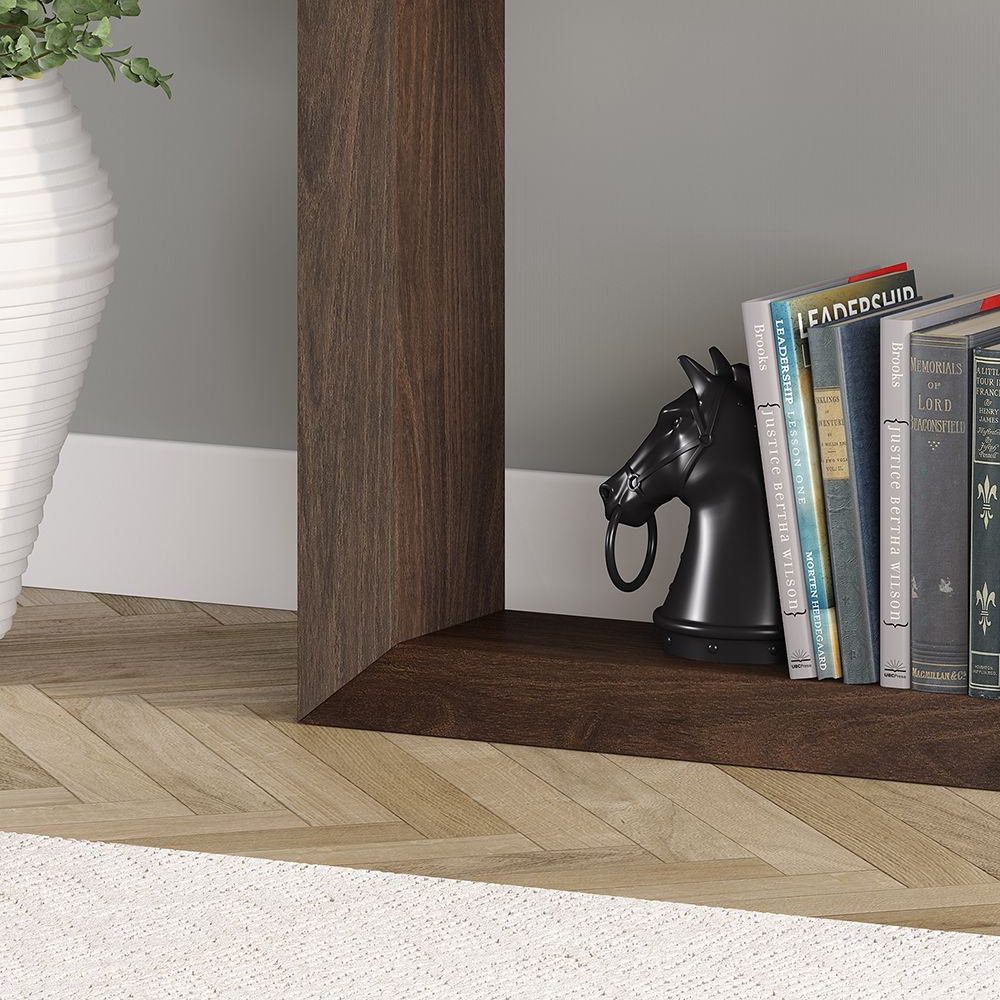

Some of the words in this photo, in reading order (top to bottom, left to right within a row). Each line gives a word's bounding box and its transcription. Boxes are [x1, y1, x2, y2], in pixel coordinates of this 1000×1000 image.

[753, 323, 768, 372] Brooks
[891, 342, 904, 388] Brooks
[911, 356, 963, 375] MEMORIALS
[927, 381, 941, 390] OF
[976, 377, 994, 387] TOUR
[774, 319, 794, 405] LEADERSHIP
[787, 410, 802, 468] LESSON
[796, 474, 807, 505] ONE
[918, 393, 952, 412] LORD
[978, 407, 999, 416] HENRY
[978, 416, 999, 424] JAMES
[804, 551, 819, 599] MORTEN
